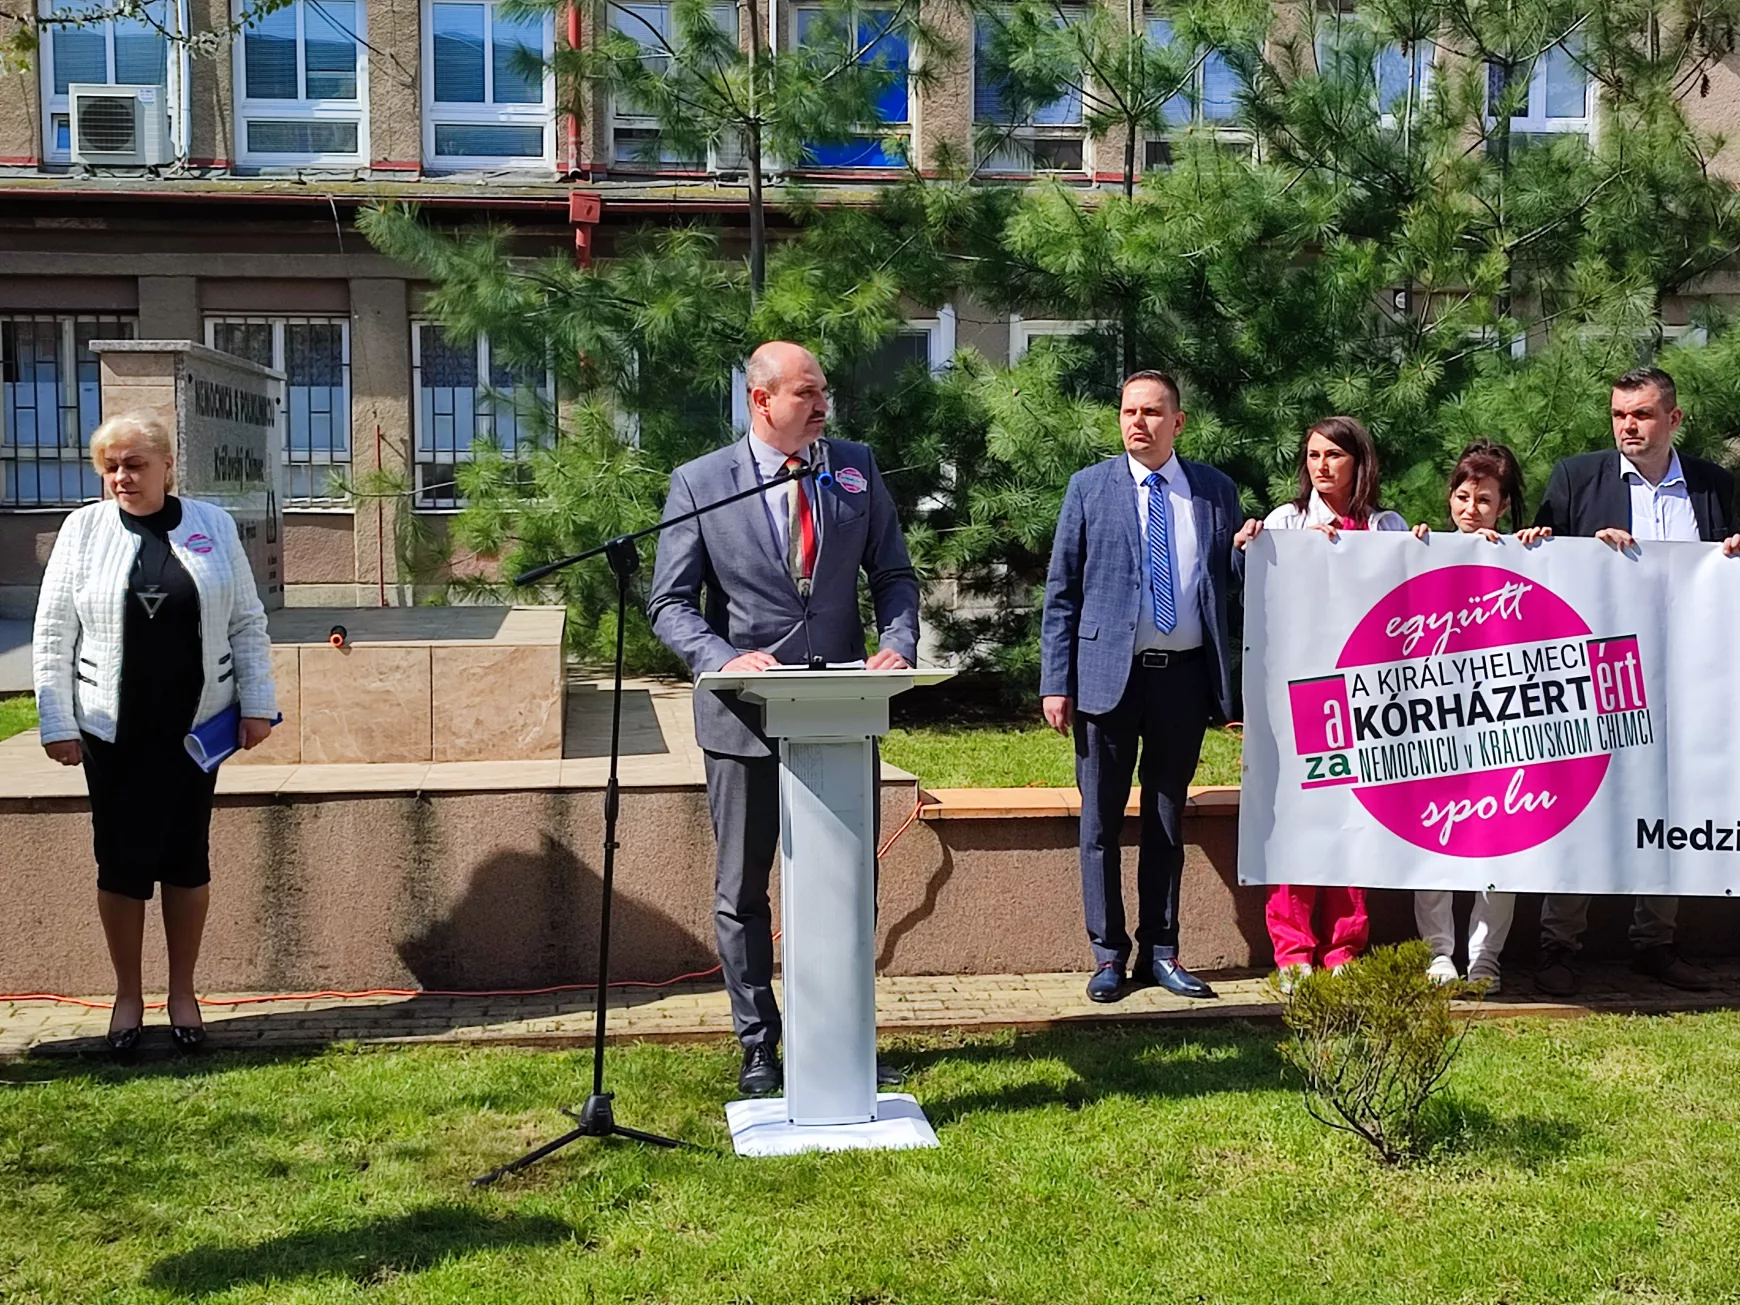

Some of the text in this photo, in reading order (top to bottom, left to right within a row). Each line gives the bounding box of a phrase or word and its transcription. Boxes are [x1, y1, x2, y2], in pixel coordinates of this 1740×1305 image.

[1385, 581, 1533, 657] együtt
[1351, 642, 1587, 698] A KIRÁLYHELMECI
[1596, 642, 1643, 711] ért
[1323, 699, 1345, 749] a
[1353, 674, 1592, 741] KÓRHÁZÉRT
[1305, 709, 1654, 783] za NEMOCNICU v KRÁĽOVSKOM CHLMCI
[1421, 768, 1558, 846] spolu
[1636, 818, 1740, 851] Medzi
